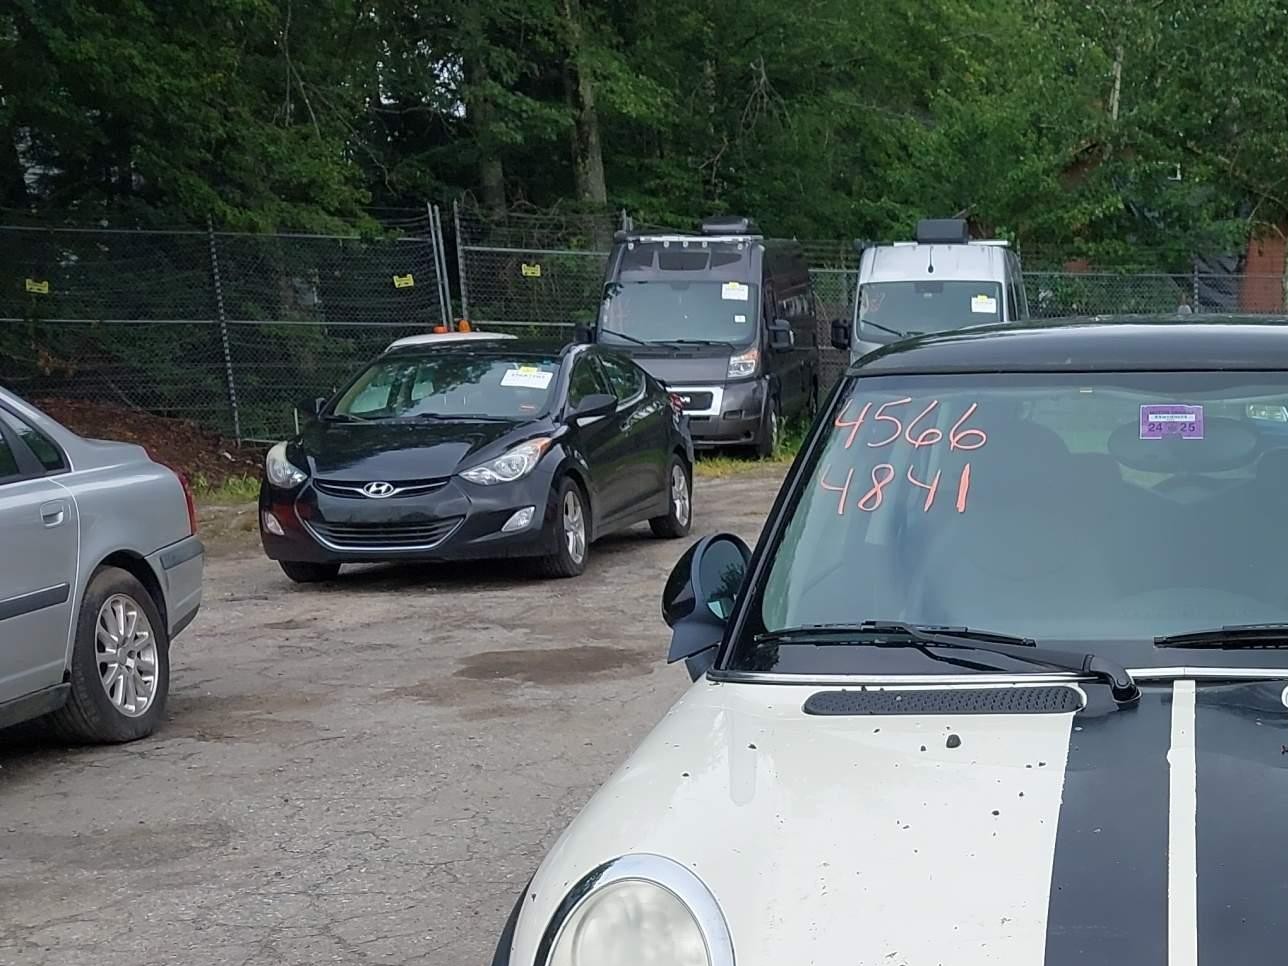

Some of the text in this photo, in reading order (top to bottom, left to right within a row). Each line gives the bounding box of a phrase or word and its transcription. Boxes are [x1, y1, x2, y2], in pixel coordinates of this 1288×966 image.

[834, 397, 987, 450] 4566
[1148, 422, 1196, 432] 24 25
[820, 462, 970, 515] 4841
